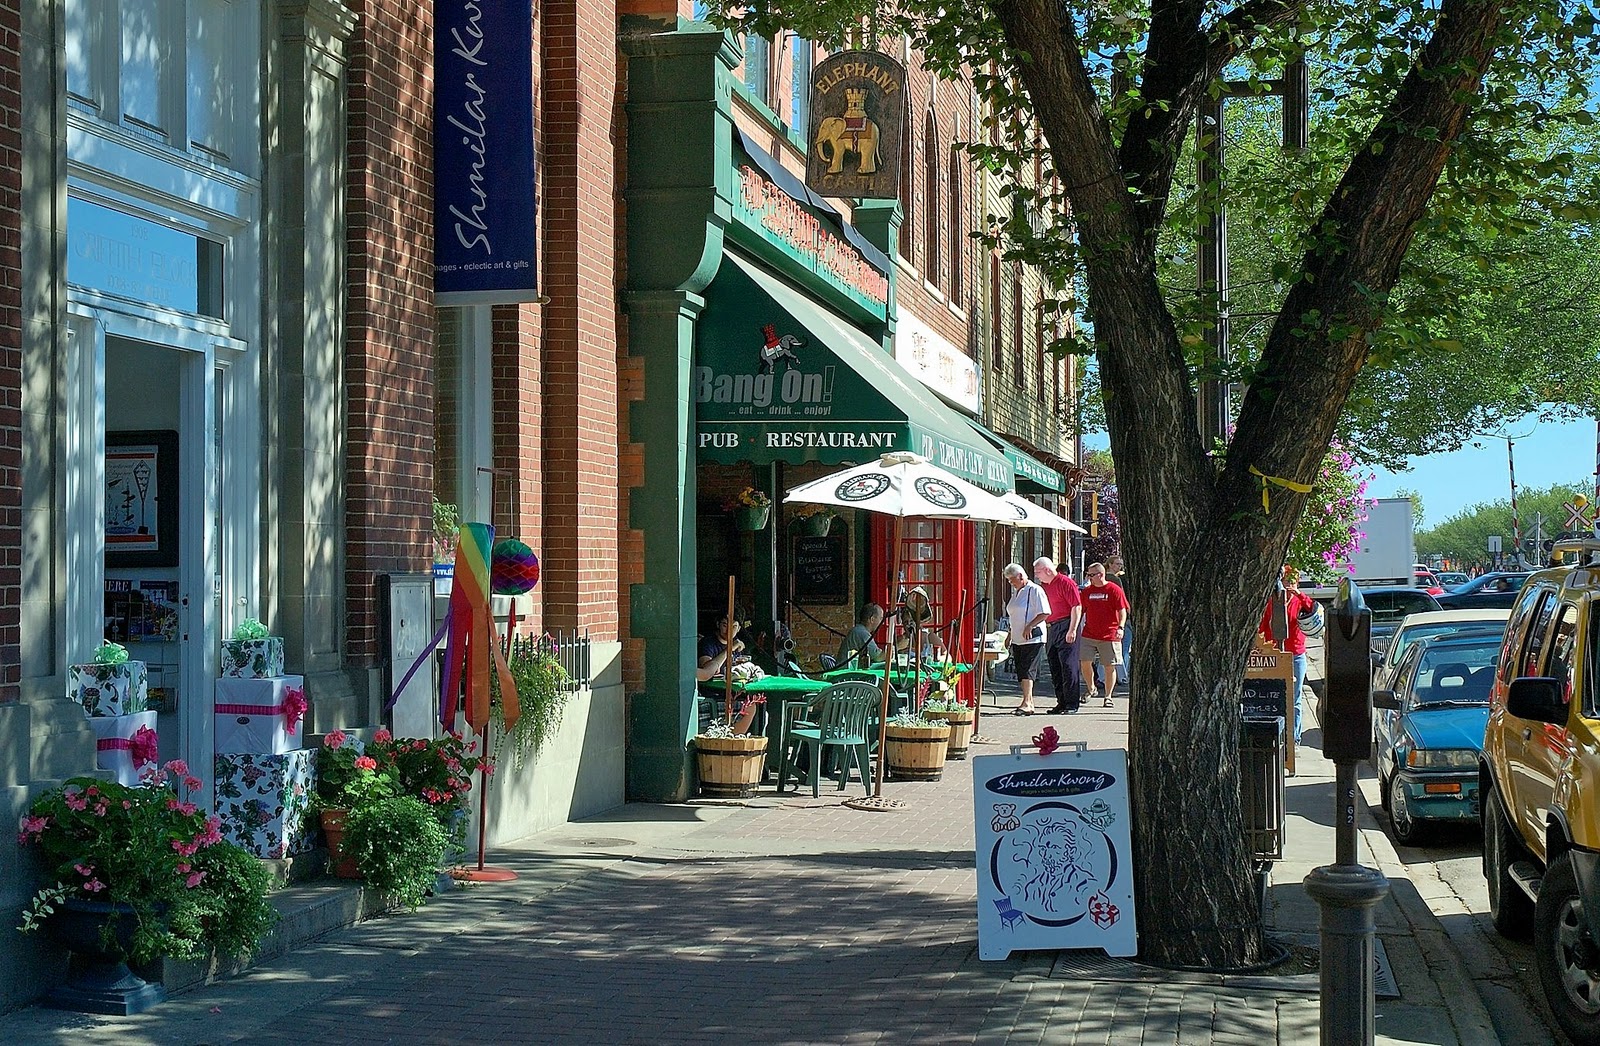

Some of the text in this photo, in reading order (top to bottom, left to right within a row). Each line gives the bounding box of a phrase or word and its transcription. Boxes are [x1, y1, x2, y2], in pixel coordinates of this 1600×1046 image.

[815, 62, 900, 95] ELEPHANT
[447, 0, 491, 255] Shmilar Kw
[131, 223, 149, 241] 1908
[434, 259, 529, 273] mages eclectic art & gifts
[696, 366, 836, 407] Bang On!
[739, 406, 753, 415] eat
[769, 405, 792, 415] drink
[804, 405, 832, 416] enjoy!
[700, 432, 897, 448] PUB RESTAURANT
[997, 772, 1105, 790] Shmilar Kwong
[1348, 789, 1355, 798] S
